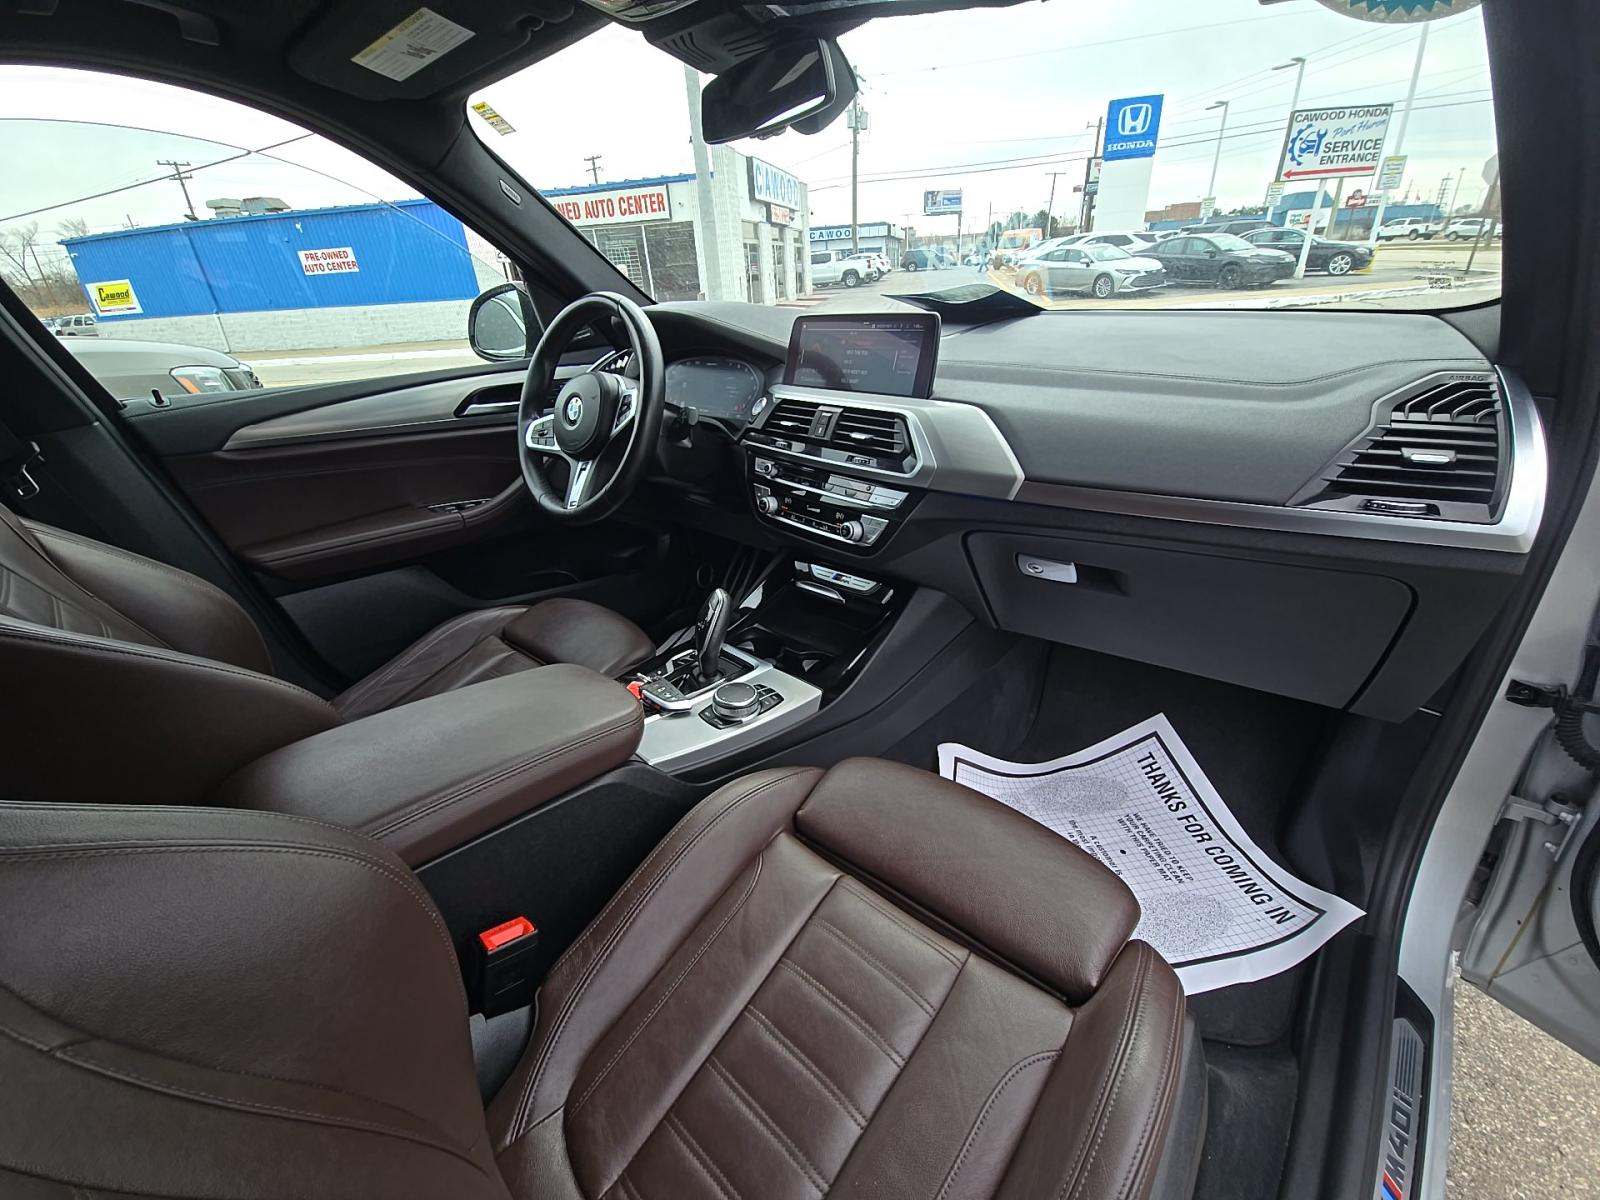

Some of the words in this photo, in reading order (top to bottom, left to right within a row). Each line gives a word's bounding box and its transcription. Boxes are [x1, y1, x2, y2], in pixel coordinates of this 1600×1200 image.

[1295, 110, 1346, 124] CAWOOD
[1348, 107, 1390, 119] HONDA
[1106, 140, 1155, 152] HONDA
[1322, 138, 1382, 153] SERVICE
[1319, 151, 1380, 165] ENTRANCE
[755, 162, 800, 207] CAWOOD
[584, 198, 615, 219] AUTO
[618, 192, 666, 217] CENTER
[809, 229, 860, 240] CAWOO
[304, 249, 350, 261] PRE-OWNED
[304, 262, 326, 273] AUTO
[326, 260, 359, 272] CENTER
[98, 287, 130, 302] Cawood
[1137, 751, 1187, 813] THANKS
[1177, 814, 1213, 844] FOR
[1204, 845, 1273, 906] COMING
[1265, 906, 1297, 925] IN
[1117, 818, 1133, 834] WITH
[1130, 833, 1143, 848] THIS
[1140, 847, 1161, 871] PAPER
[1158, 867, 1174, 883] MAT
[1124, 813, 1141, 834] YOUR
[1136, 830, 1167, 863] CARPETING
[1164, 862, 1186, 884] CLEAN
[1141, 822, 1157, 839] HAVE
[1153, 838, 1172, 857] TRIED
[1177, 863, 1194, 882] KEEP
